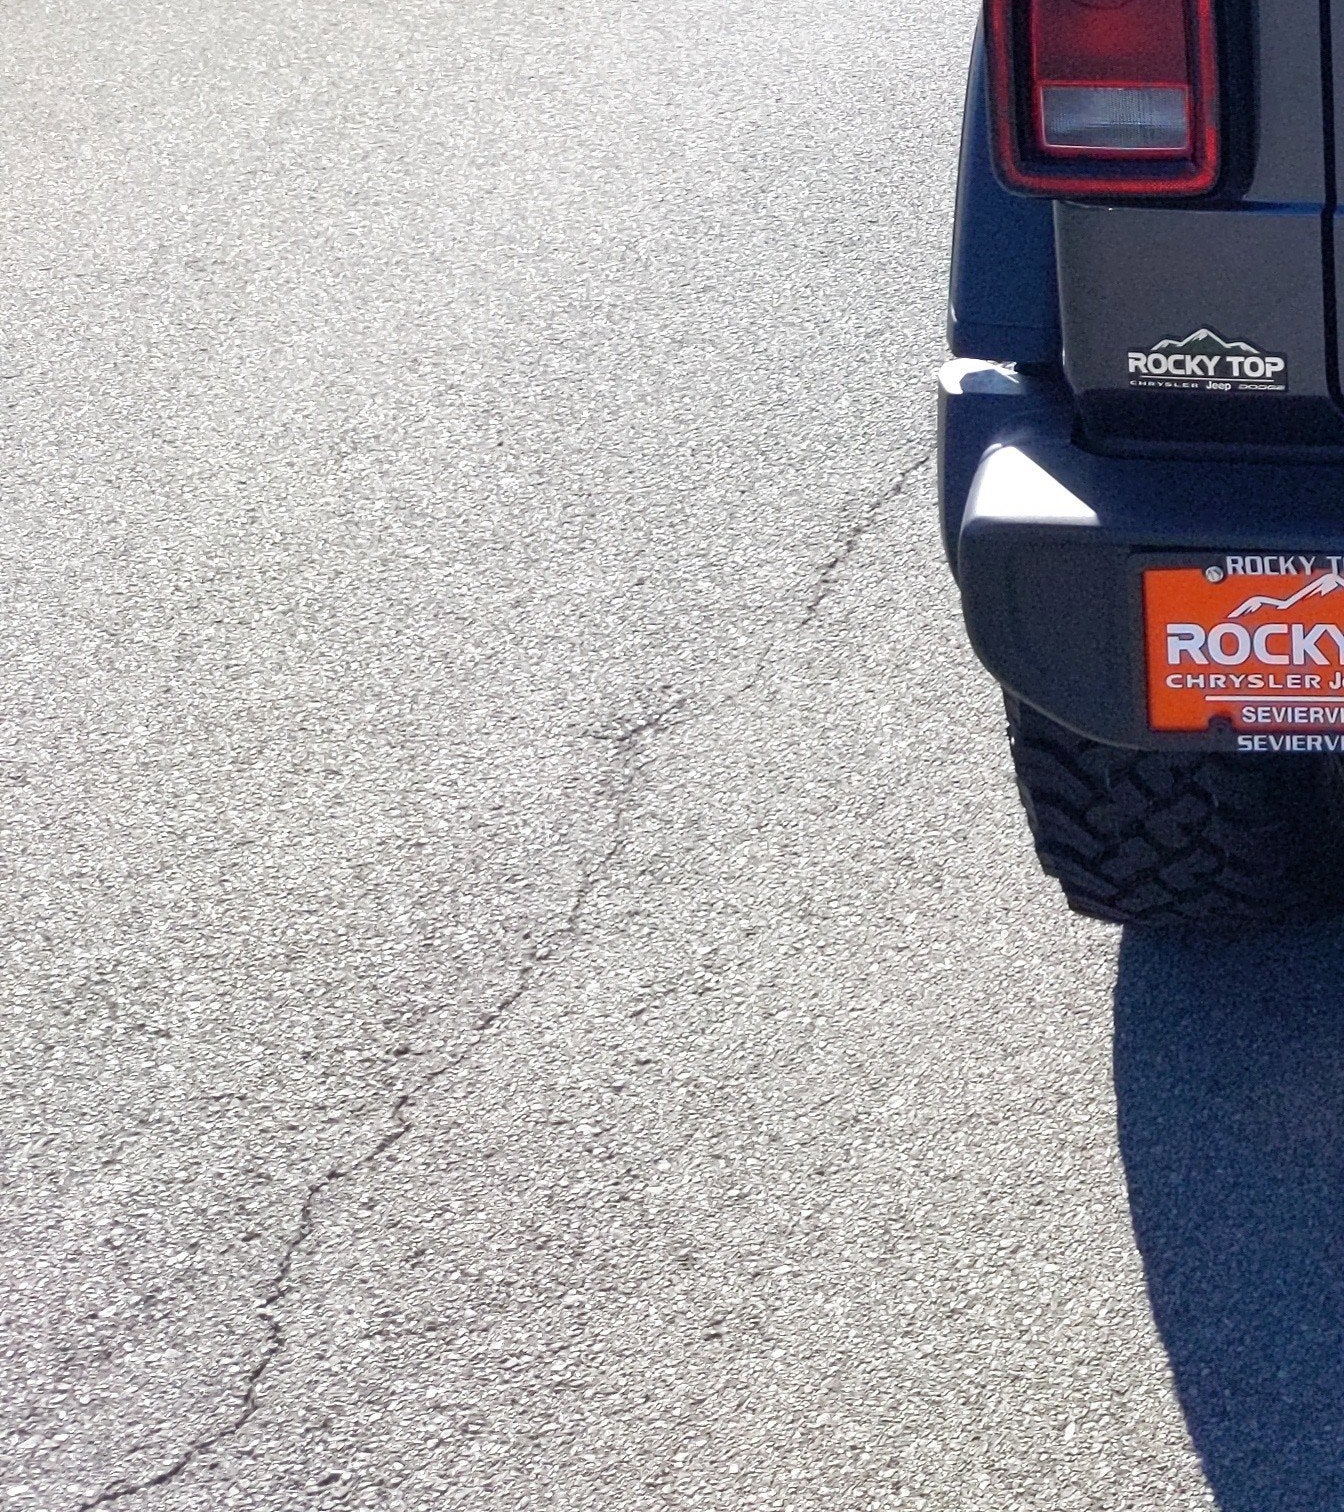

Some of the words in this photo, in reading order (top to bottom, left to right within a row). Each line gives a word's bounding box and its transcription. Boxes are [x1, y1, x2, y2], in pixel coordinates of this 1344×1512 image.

[1128, 352, 1220, 376] ROCKY
[1226, 356, 1285, 378] TOP
[1129, 380, 1199, 388] CHRYSLER
[1206, 381, 1232, 391] Jeep
[1226, 555, 1326, 576] ROCKY
[1166, 673, 1321, 689] CHRYSLER
